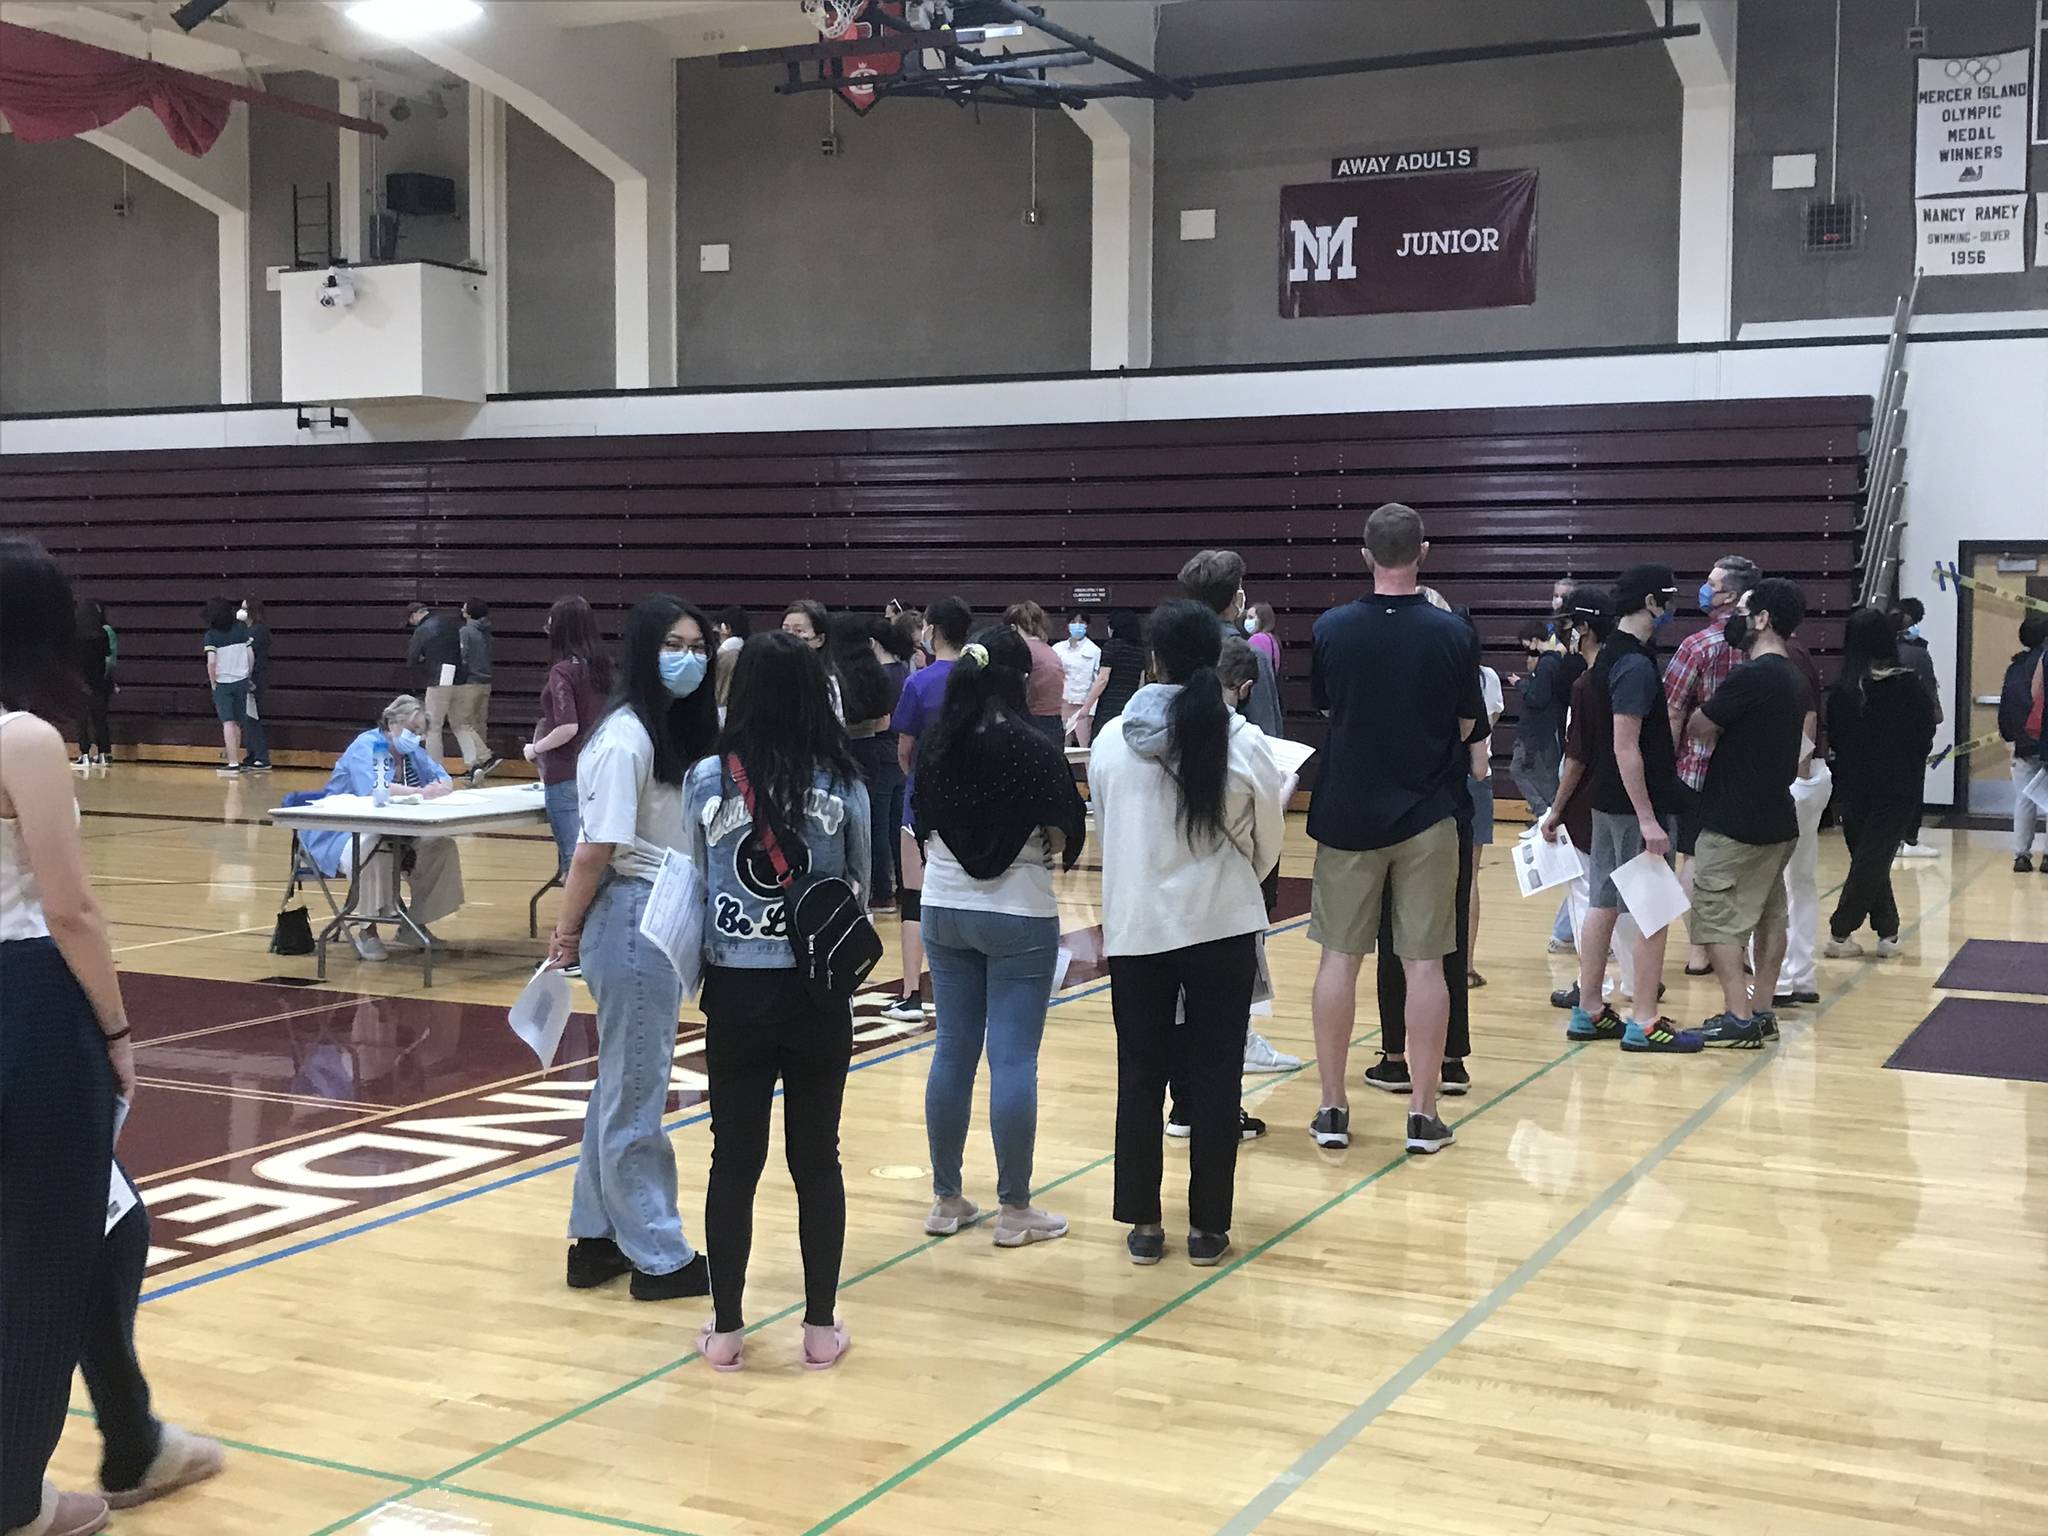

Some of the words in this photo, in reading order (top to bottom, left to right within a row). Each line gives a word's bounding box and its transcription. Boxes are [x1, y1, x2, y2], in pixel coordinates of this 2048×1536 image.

[1919, 88, 1972, 104] MERCER
[1978, 82, 2027, 100] ISLAND
[1942, 105, 2002, 122] OLYMPIC
[1948, 127, 1995, 142] MEDAL
[1337, 156, 1391, 176] AWAY
[1396, 149, 1471, 170] ADULTS
[1939, 146, 2003, 162] WINNERS
[1923, 208, 1966, 222] NANCY
[1975, 204, 2019, 221] RAMEY
[1396, 228, 1498, 257] JUNIOR
[1951, 250, 1986, 265] 1956
[717, 895, 753, 936] Be
